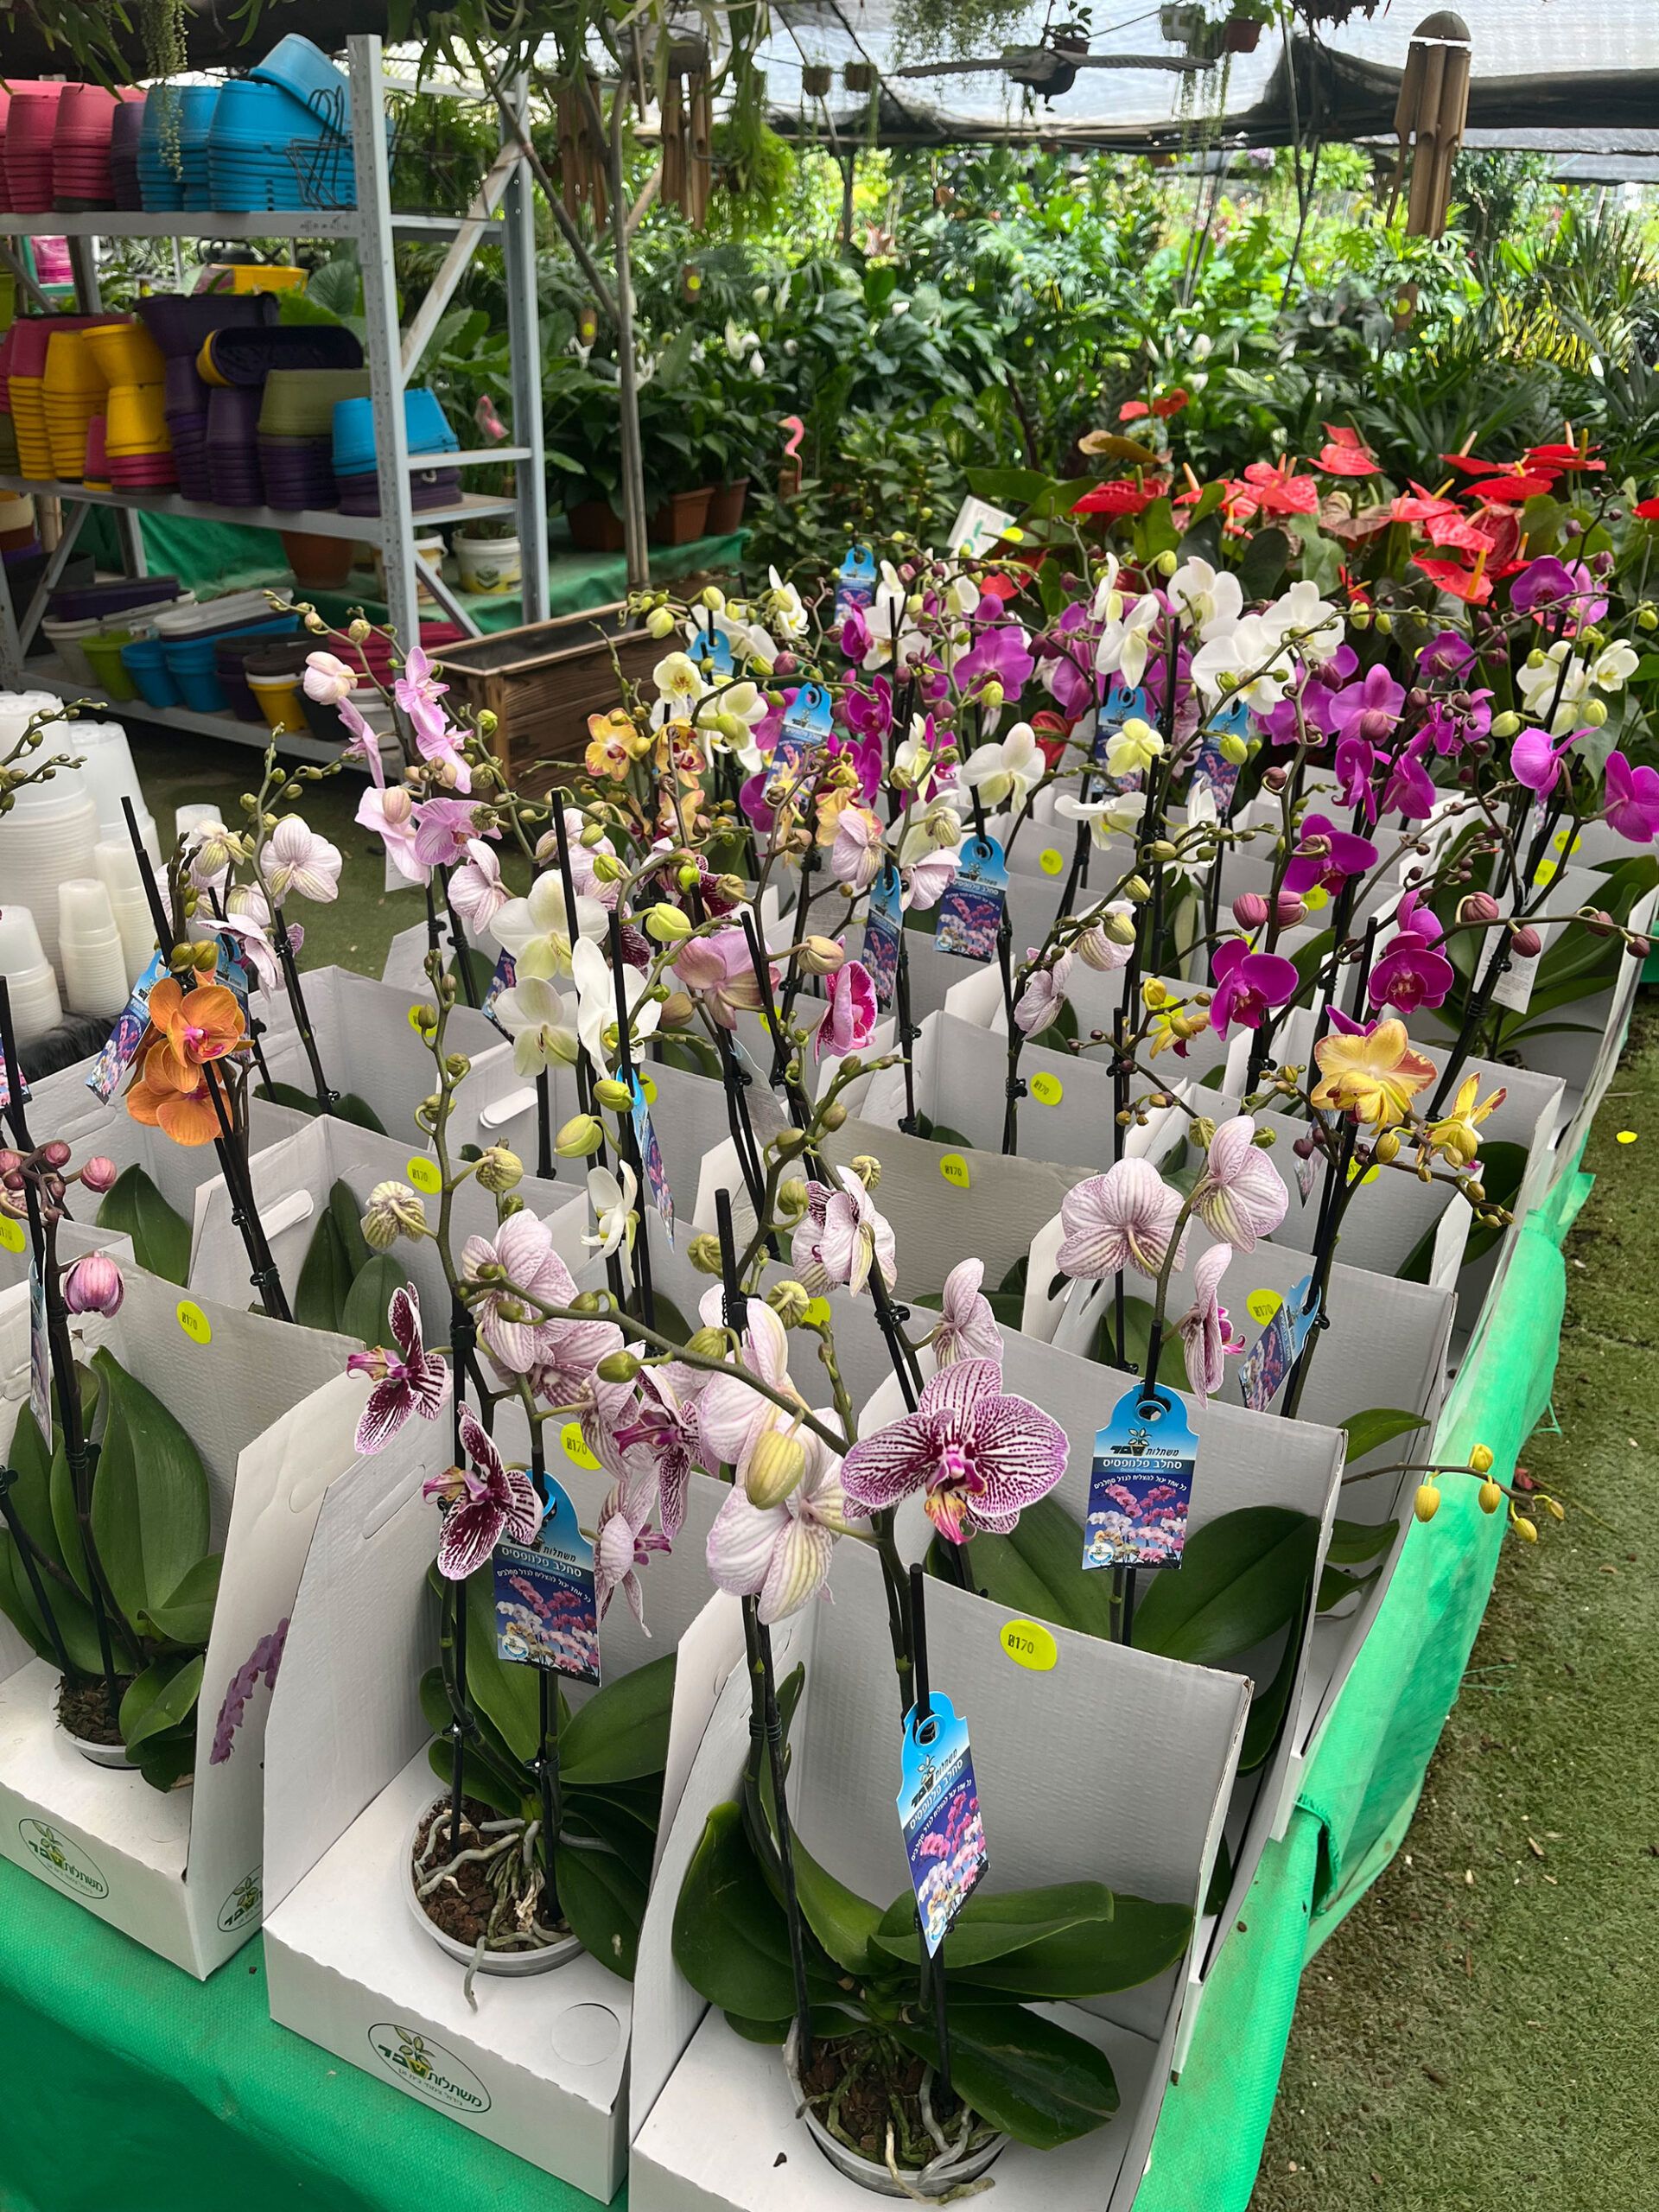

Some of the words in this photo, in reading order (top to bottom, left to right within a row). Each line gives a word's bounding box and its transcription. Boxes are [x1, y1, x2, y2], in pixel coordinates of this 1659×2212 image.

[1146, 1446, 1179, 1457] משתלות
[1103, 1458, 1150, 1468] פלנופסיס
[1154, 1459, 1182, 1470] סחלב
[1093, 1478, 1116, 1490] סחלבים
[1167, 1479, 1179, 1488] אחד
[1180, 1483, 1187, 1491] כל
[501, 1547, 550, 1567] פלנופסיס
[543, 1546, 576, 1562] משתלות
[552, 1561, 582, 1578] סחלב
[569, 1586, 583, 1597] אחד
[584, 1594, 591, 1603] כל
[944, 1758, 963, 1785] סחלב
[909, 1785, 942, 1830] פלנופסיס
[65, 1862, 104, 1892] משתלות
[428, 2072, 482, 2107] משתלות
